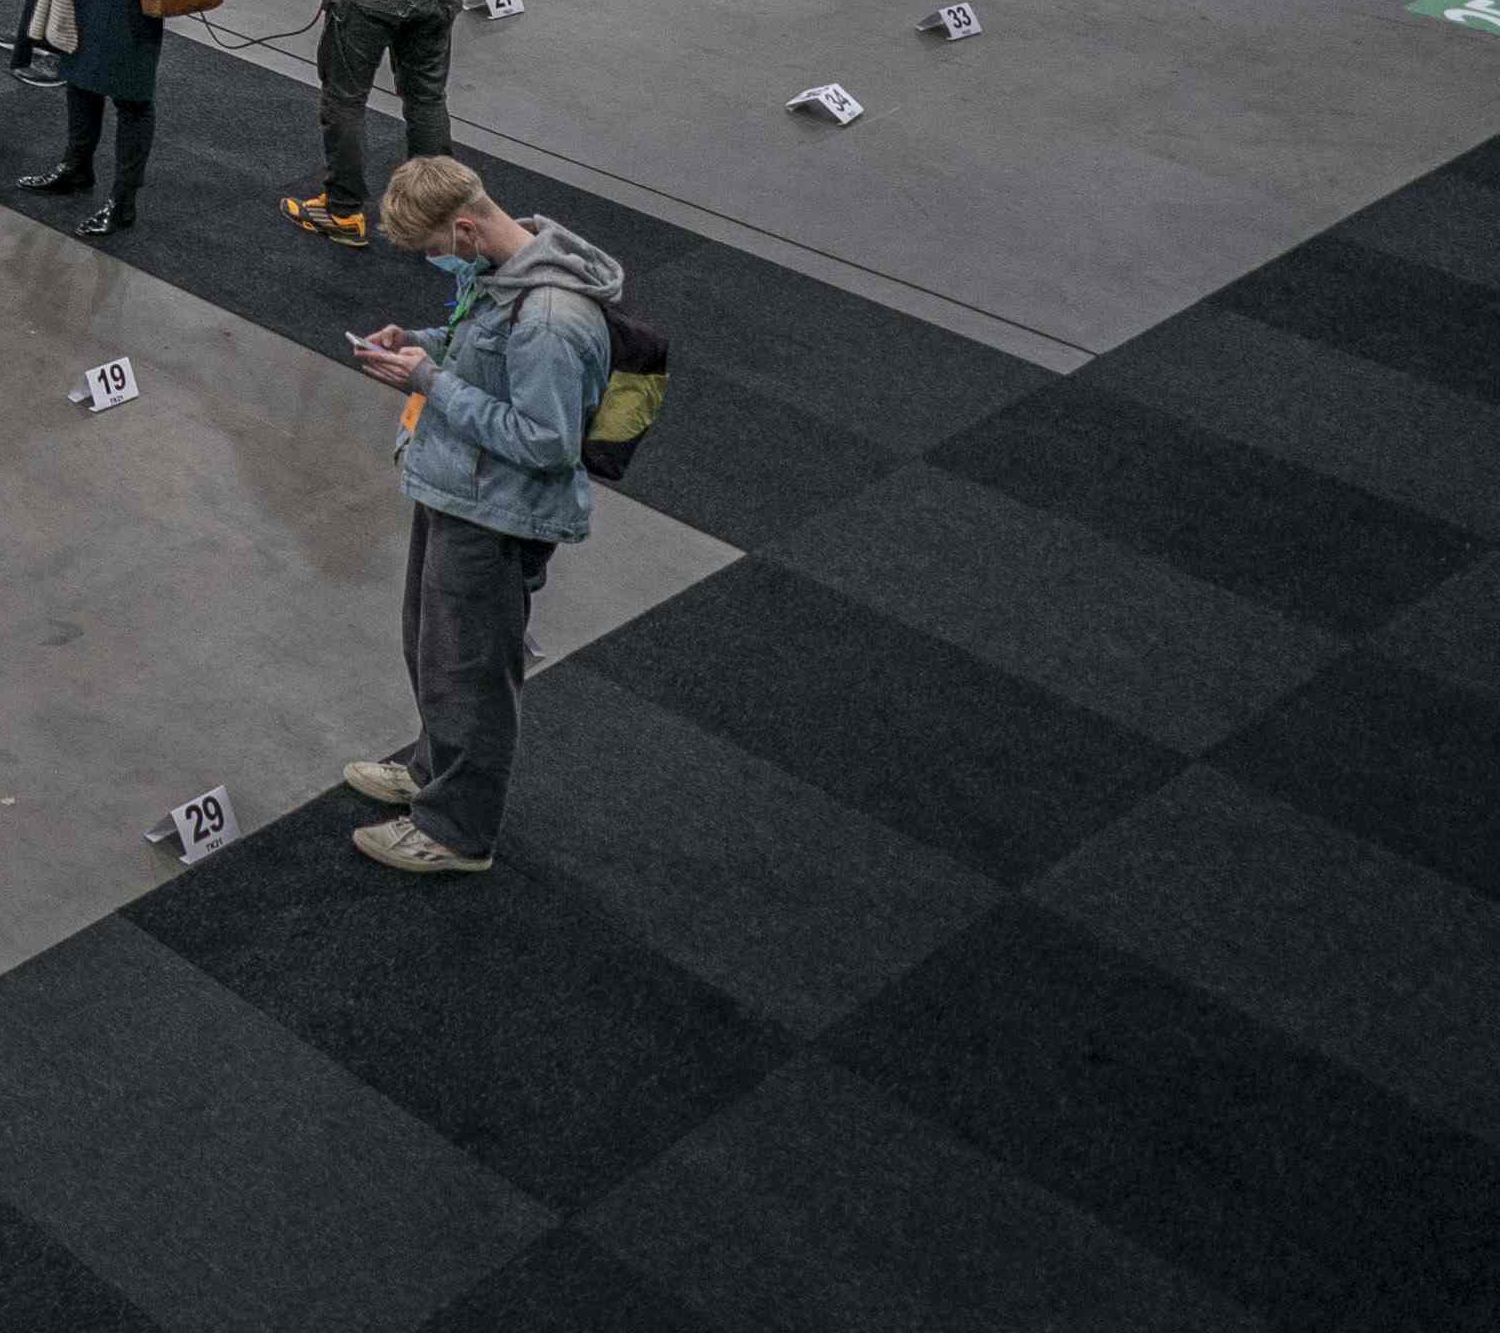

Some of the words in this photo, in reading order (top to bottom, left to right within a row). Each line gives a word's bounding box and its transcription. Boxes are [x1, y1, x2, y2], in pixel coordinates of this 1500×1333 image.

[948, 7, 971, 27] 33
[98, 364, 125, 395] 19
[186, 796, 225, 835] 29
